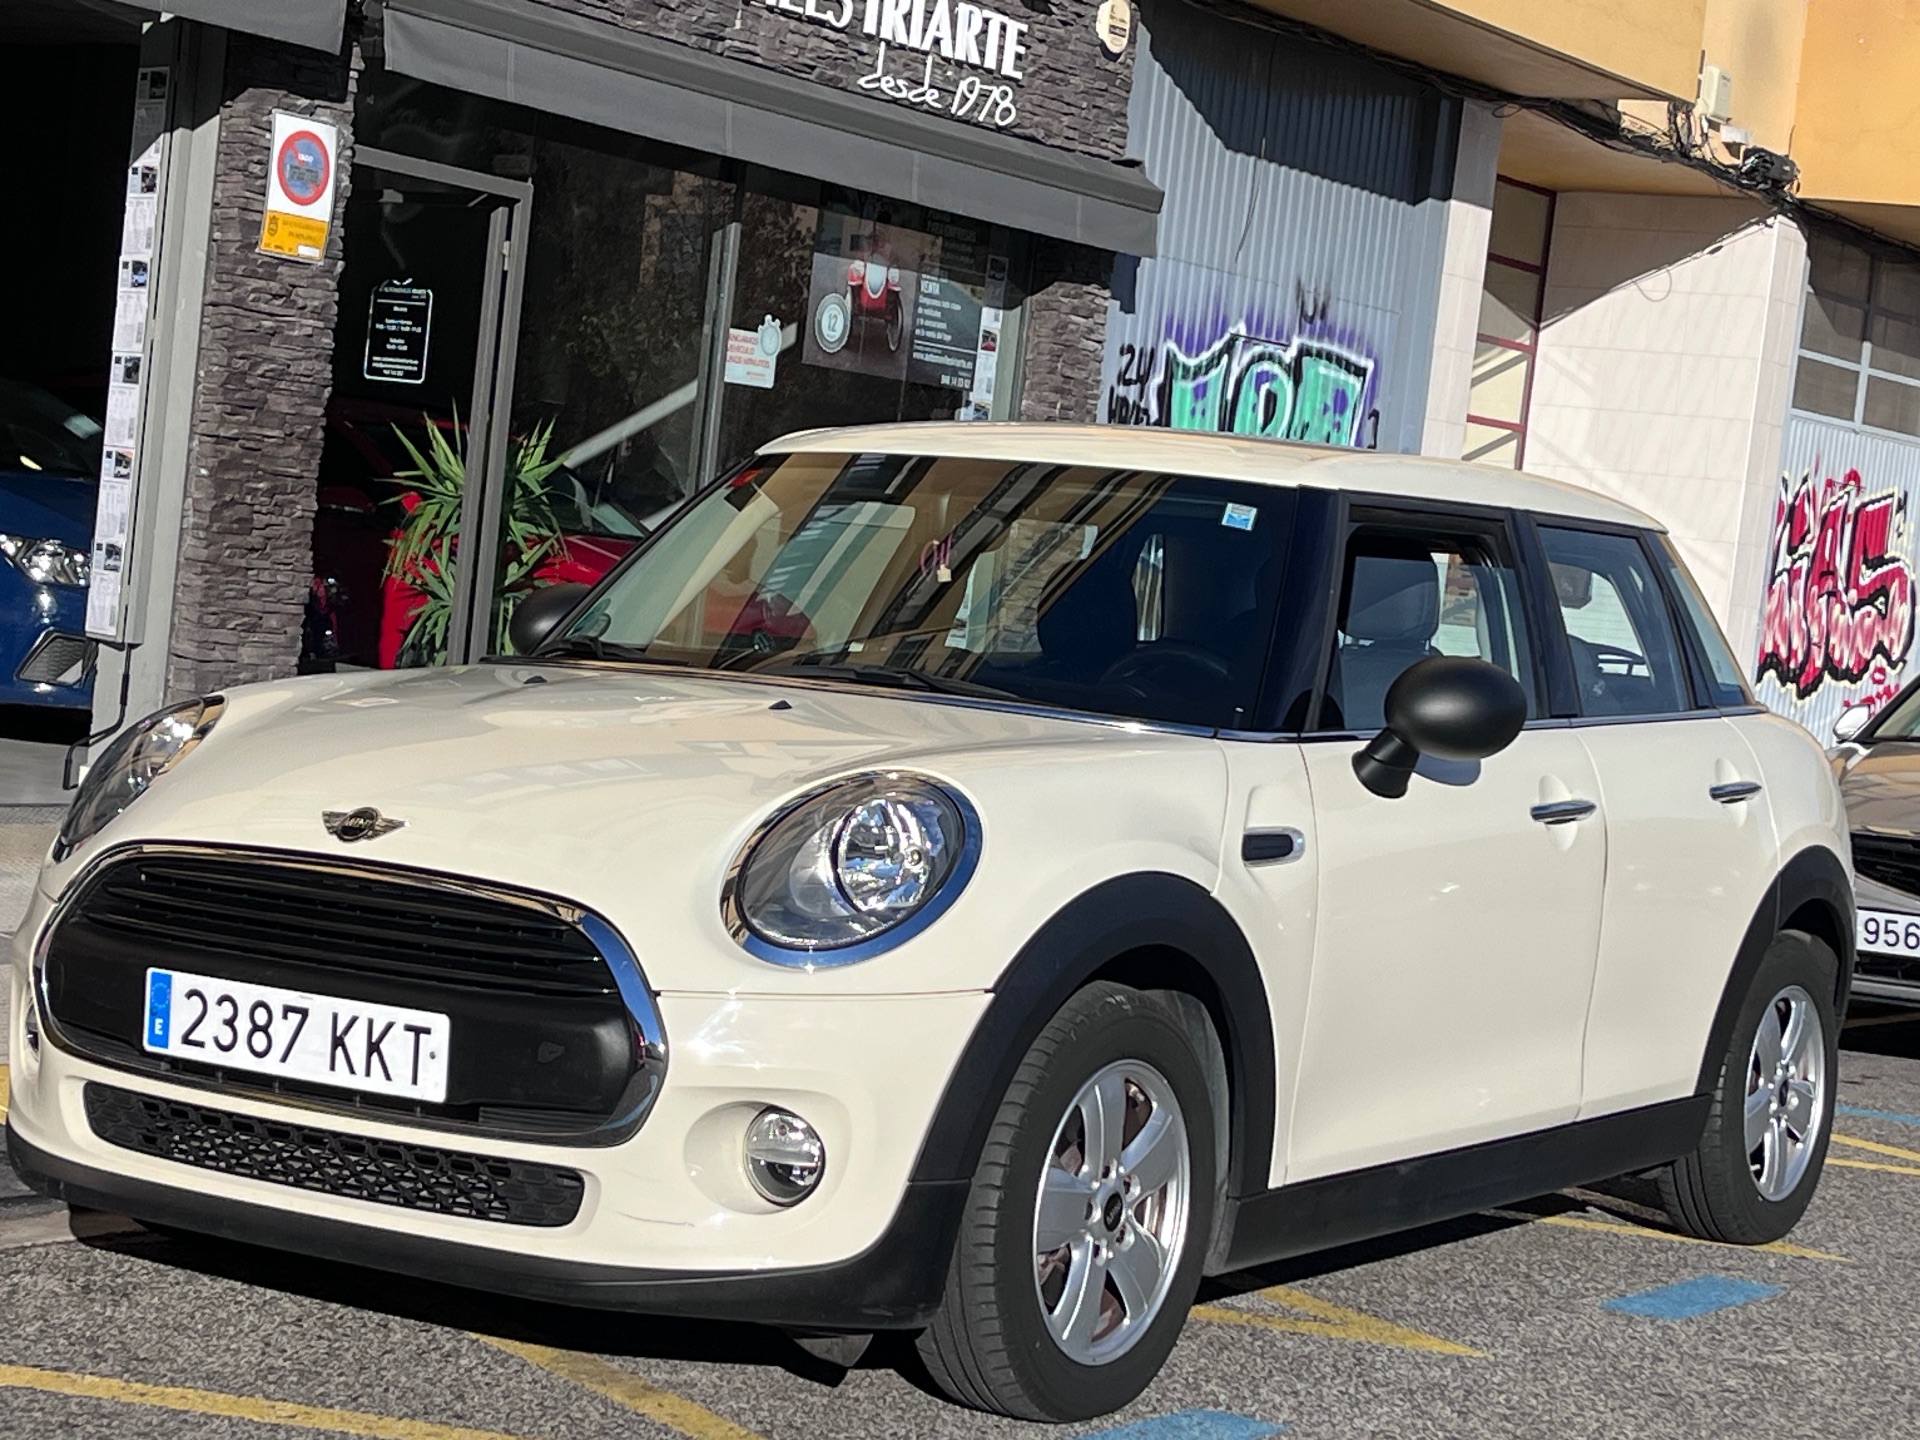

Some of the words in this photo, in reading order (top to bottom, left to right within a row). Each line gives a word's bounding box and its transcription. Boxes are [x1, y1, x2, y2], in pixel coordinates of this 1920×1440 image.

[857, 40, 943, 109] desde
[951, 76, 1017, 126] 1978
[1864, 917, 1920, 950] 956
[154, 1018, 164, 1036] E
[181, 988, 310, 1064] 2387
[328, 1012, 432, 1086] KKT
